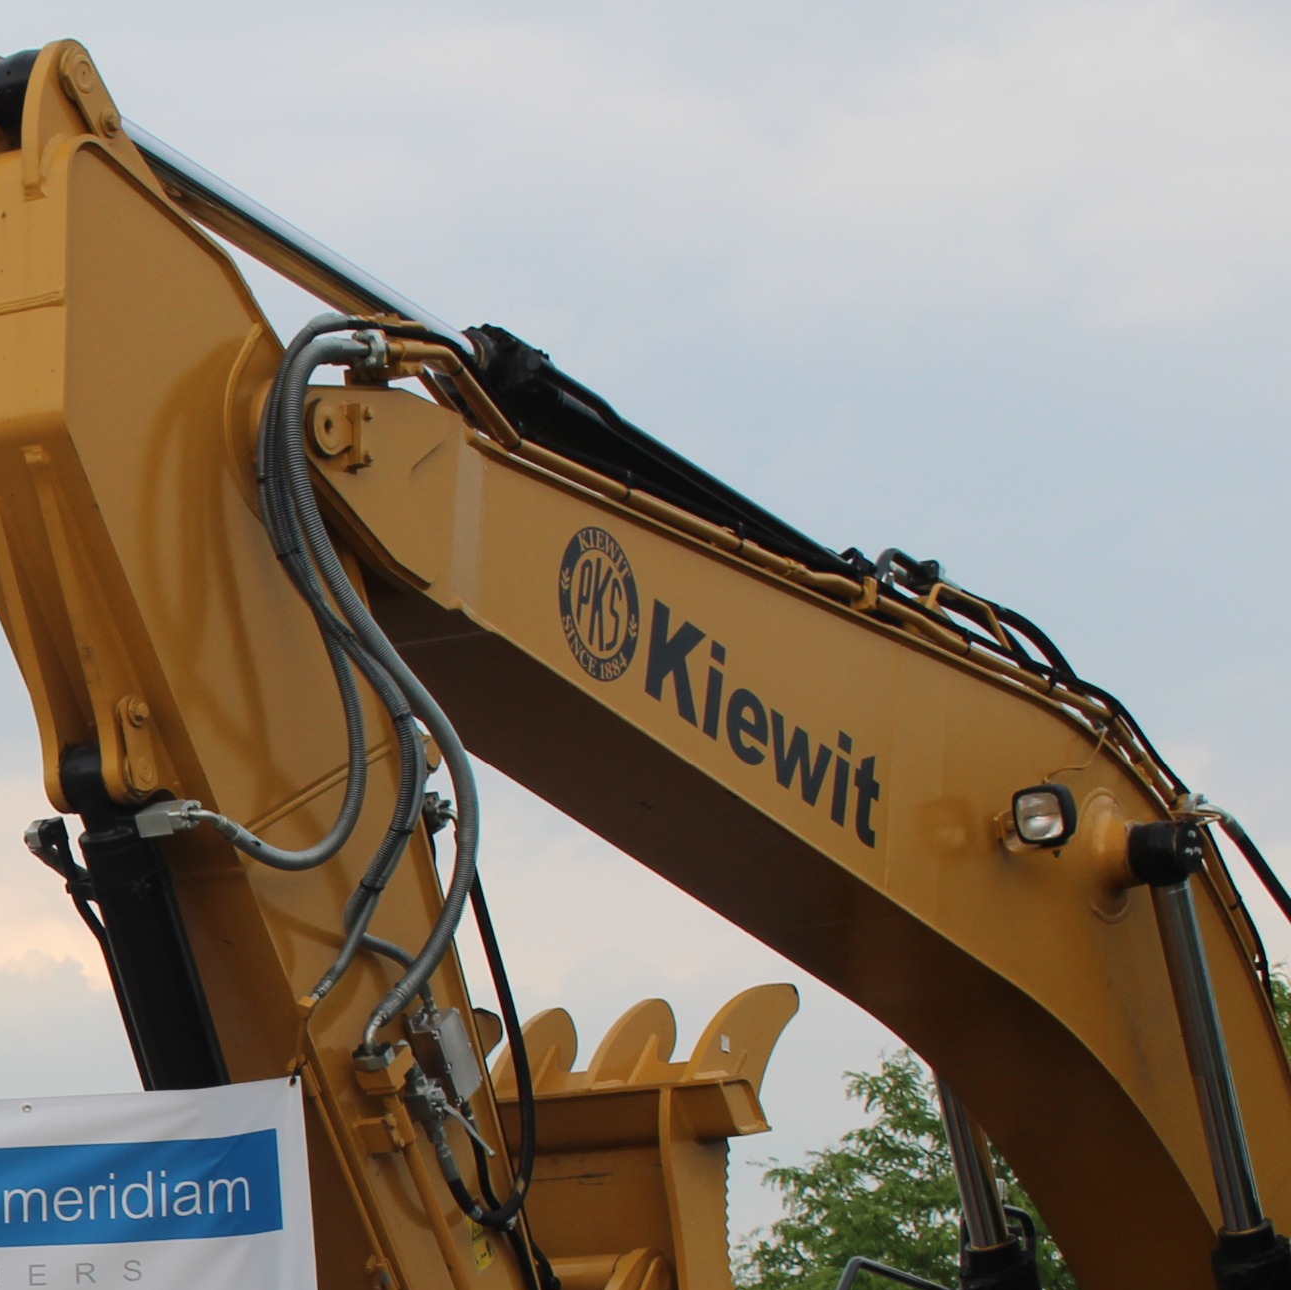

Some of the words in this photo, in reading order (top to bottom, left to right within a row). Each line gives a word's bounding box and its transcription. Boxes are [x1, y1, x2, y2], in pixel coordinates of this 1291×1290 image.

[577, 529, 631, 581] KIEWIT
[576, 557, 622, 652] PKS
[562, 615, 597, 676] SINCE
[599, 651, 627, 680] 1884
[644, 598, 880, 849] Kiewit
[3, 1170, 251, 1223] meridiam
